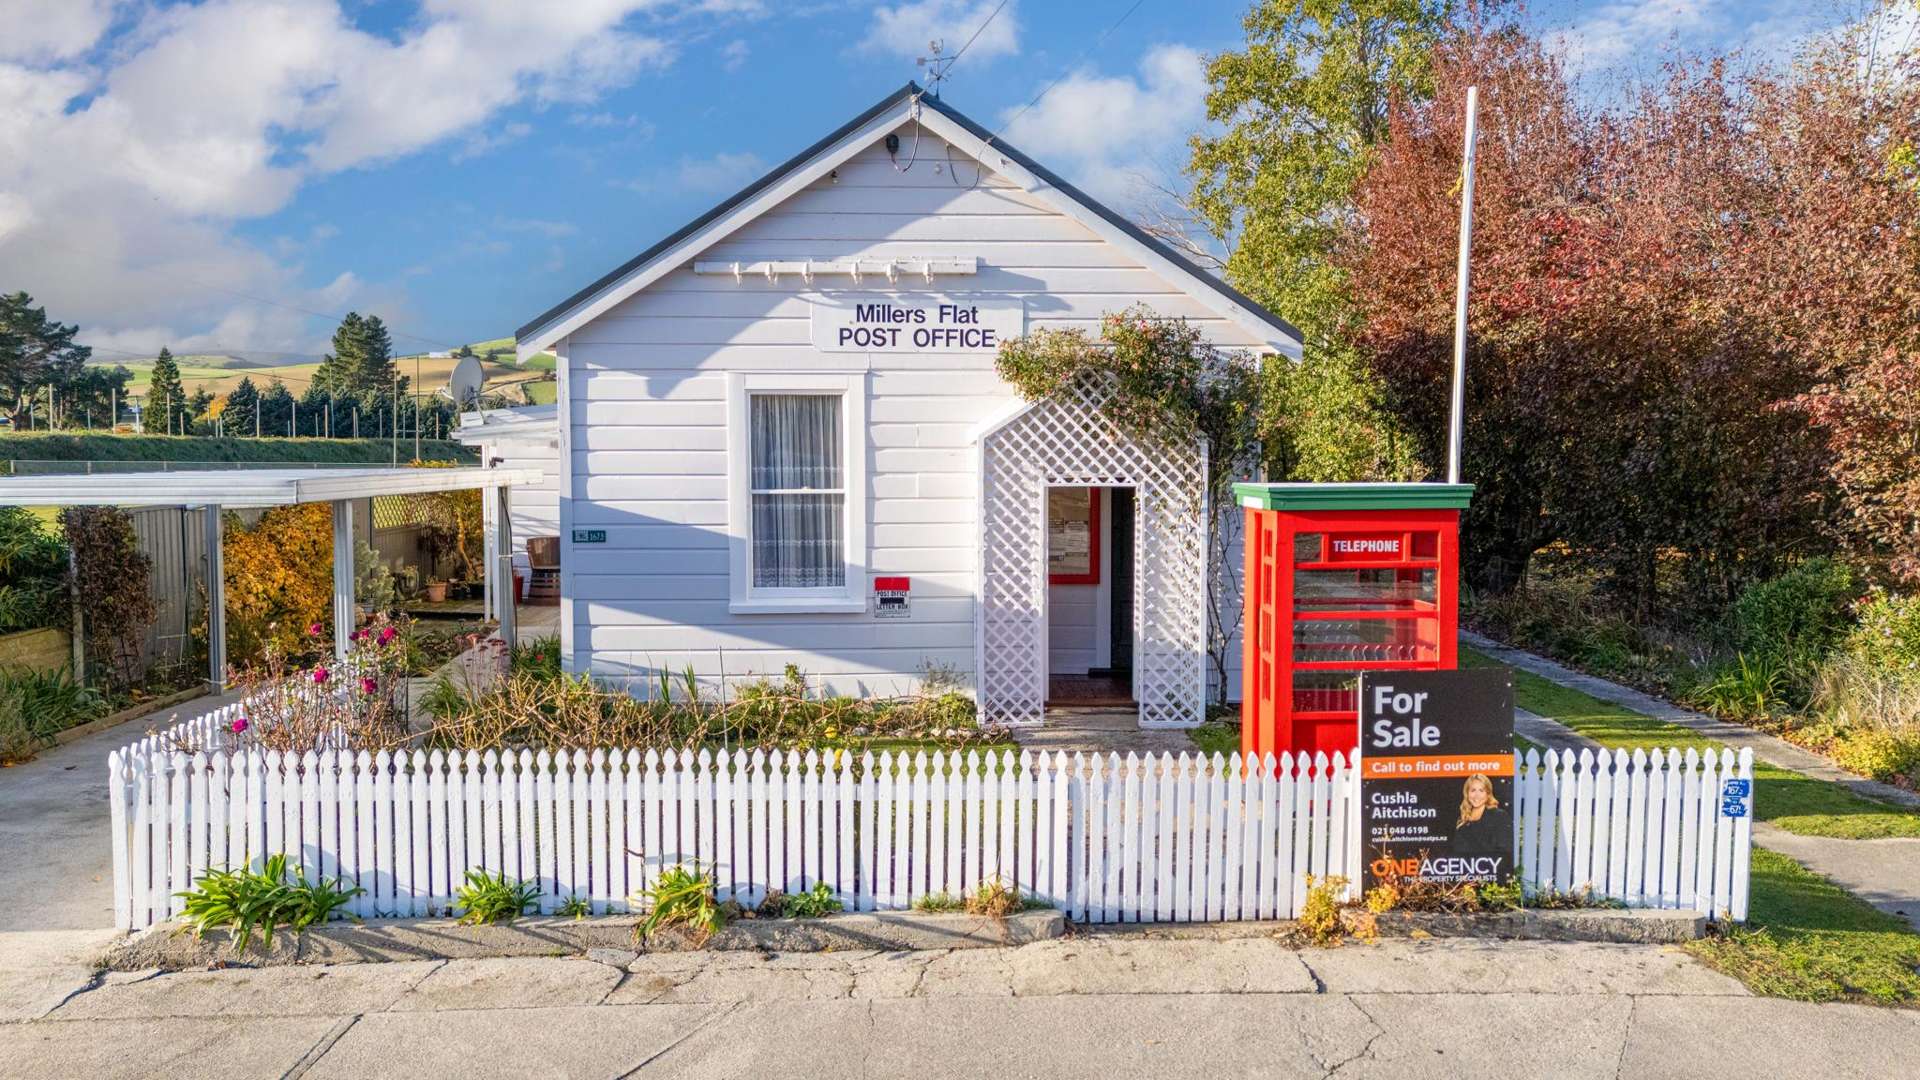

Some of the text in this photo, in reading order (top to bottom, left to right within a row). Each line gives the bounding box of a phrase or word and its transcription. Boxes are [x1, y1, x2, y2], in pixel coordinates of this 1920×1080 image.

[856, 304, 979, 325] Millers Flat
[839, 327, 996, 348] POST OFFICE
[1333, 540, 1399, 552] TELEPHONE
[1374, 685, 1428, 715] For
[1372, 718, 1441, 748] Sale
[1371, 761, 1500, 773] Call to find out more
[1371, 791, 1418, 804] Cushla
[1371, 806, 1437, 819] Aitchison
[1407, 826, 1429, 834] 6198
